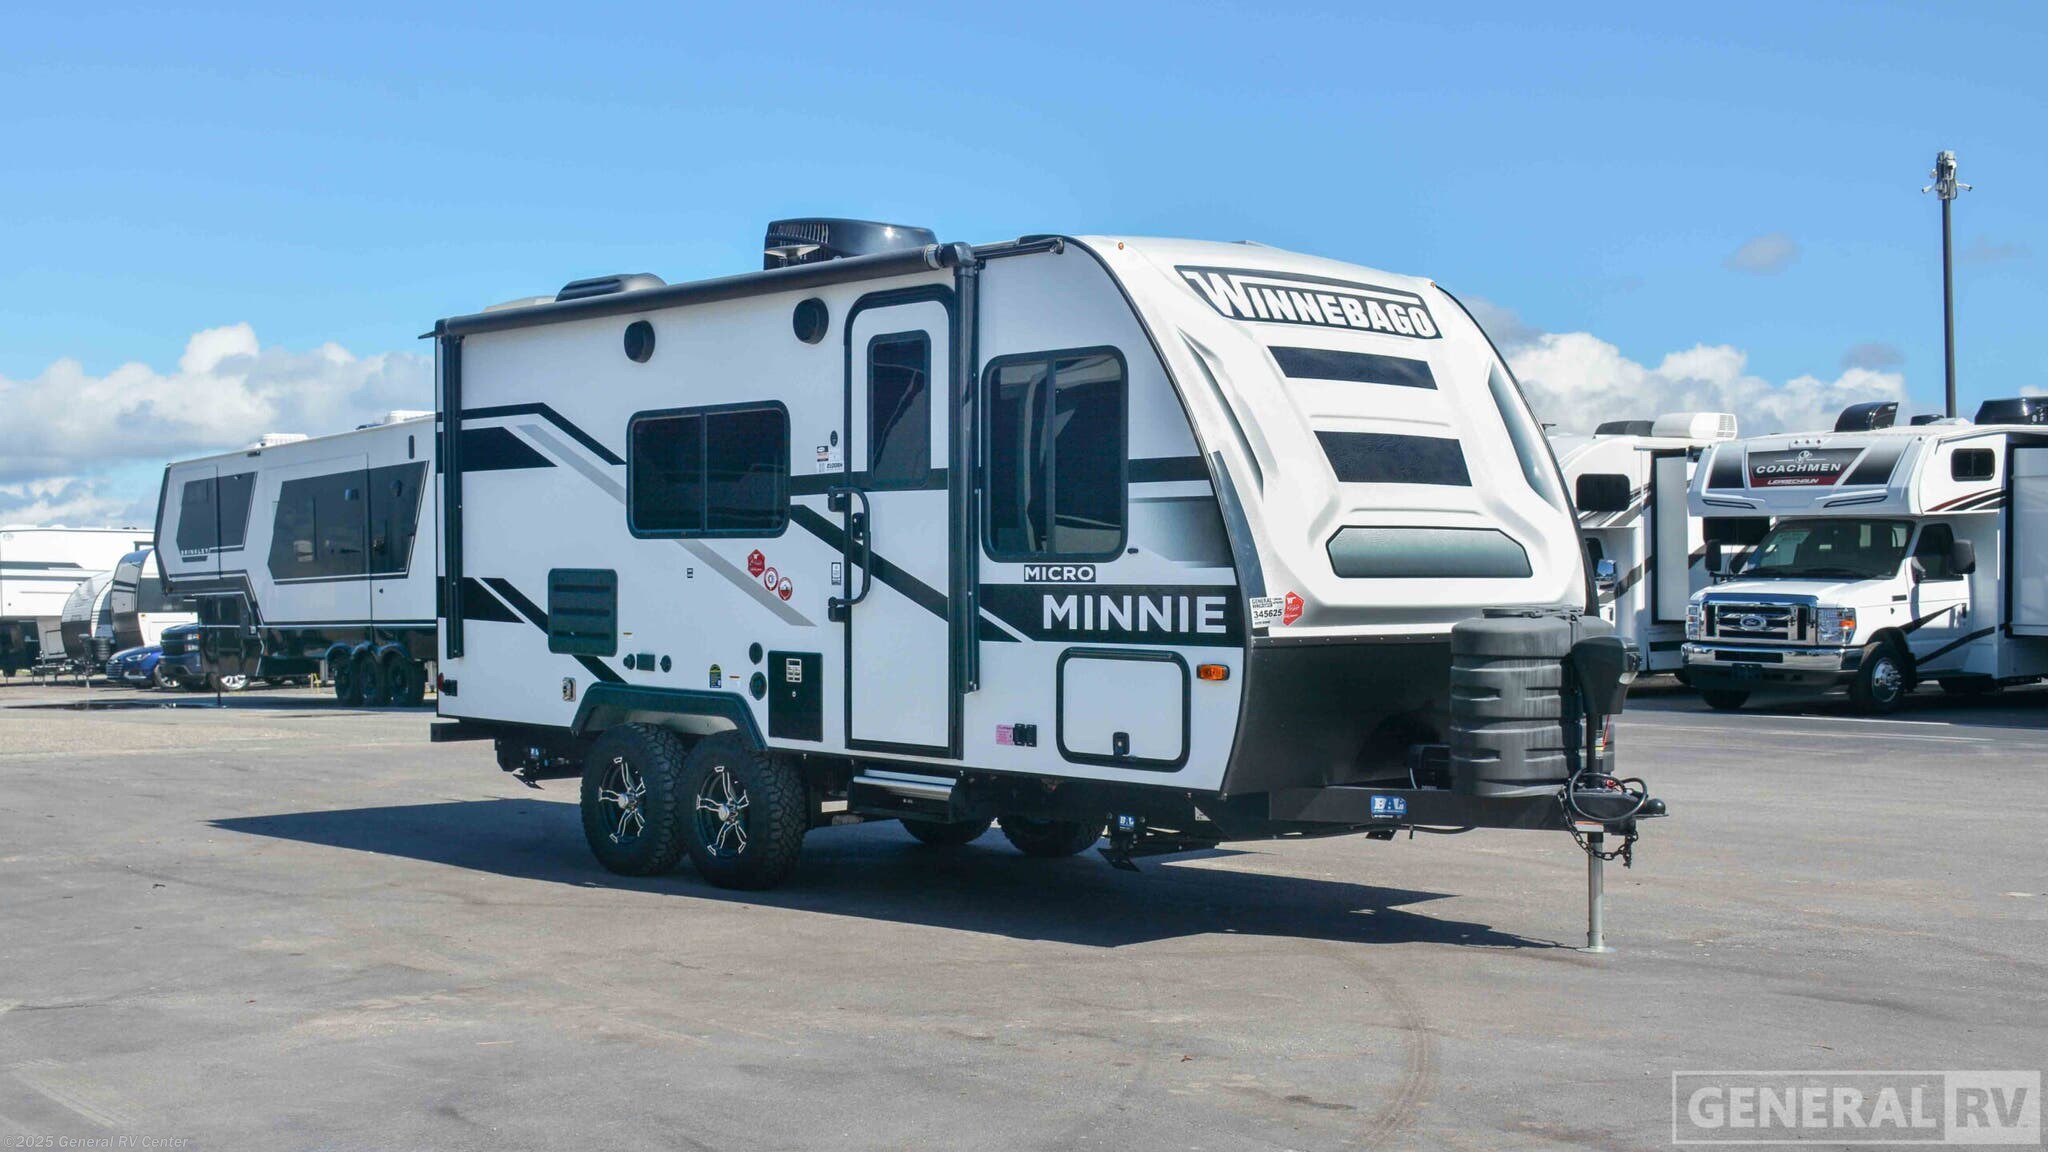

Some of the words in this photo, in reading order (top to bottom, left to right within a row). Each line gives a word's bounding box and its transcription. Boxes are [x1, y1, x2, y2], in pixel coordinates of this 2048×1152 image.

[1181, 270, 1436, 338] WINNEBAGO
[1756, 463, 1842, 474] COACHMEN
[1024, 566, 1094, 581] MICRO
[1043, 594, 1227, 634] MINNIE
[1253, 608, 1283, 619] 345625
